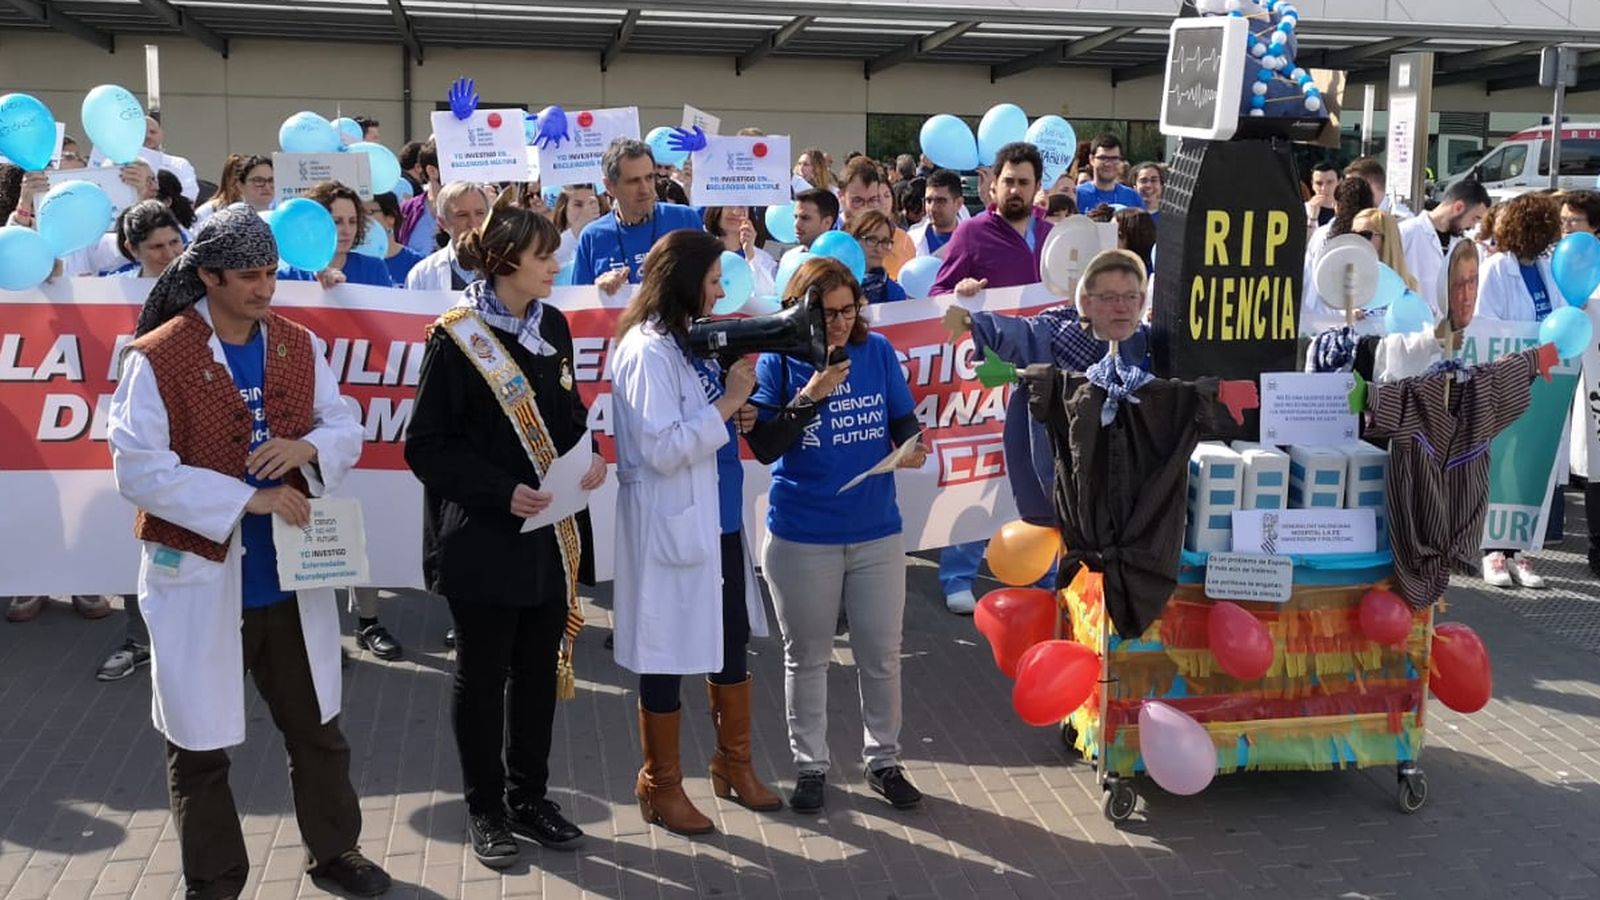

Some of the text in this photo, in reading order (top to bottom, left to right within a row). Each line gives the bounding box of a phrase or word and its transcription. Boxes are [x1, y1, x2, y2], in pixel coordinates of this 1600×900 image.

[464, 151, 497, 159] INVESTIGO
[451, 160, 489, 168] ESCLEROSIS
[552, 160, 595, 169] ESCLEROSIS
[721, 175, 756, 183] INVESTIGO
[706, 183, 746, 191] ESCLEROSIS
[1204, 210, 1289, 267] RIP
[1189, 275, 1296, 341] CIENCIA
[0, 333, 84, 382] LA
[828, 393, 884, 413] CIENCIA
[831, 409, 883, 430] NO HAY
[833, 426, 885, 446] FUTURO
[311, 548, 346, 558] INVESTIGO
